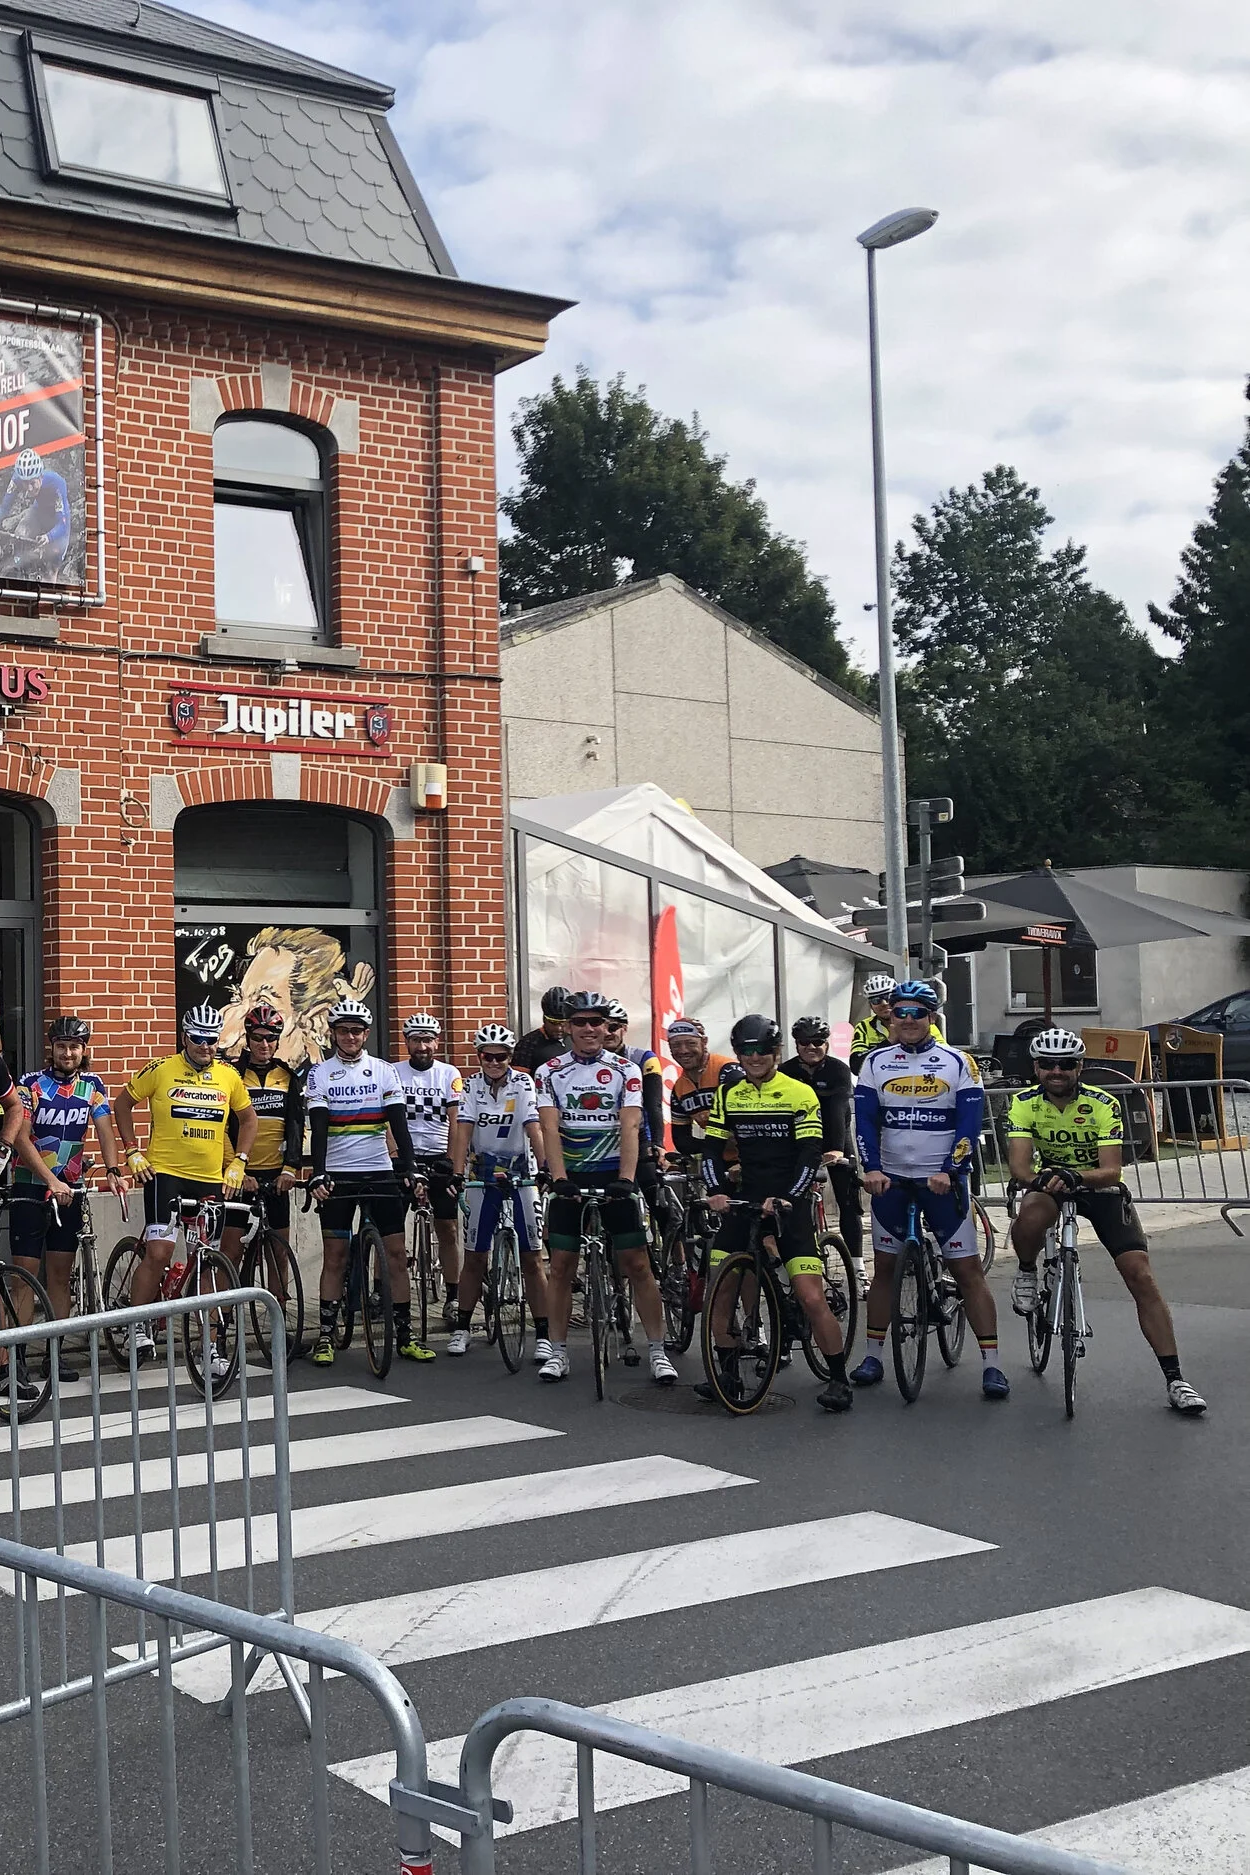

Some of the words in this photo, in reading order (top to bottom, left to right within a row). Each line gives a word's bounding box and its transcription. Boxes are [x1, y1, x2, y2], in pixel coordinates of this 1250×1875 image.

[214, 694, 356, 744] Jupiler
[171, 1089, 216, 1101] Mercatone
[890, 1083, 938, 1093] Topsport
[680, 1092, 713, 1112] OLTE
[36, 1107, 89, 1125] MAPEI
[477, 1112, 514, 1127] gan
[898, 1111, 946, 1122] Baloise
